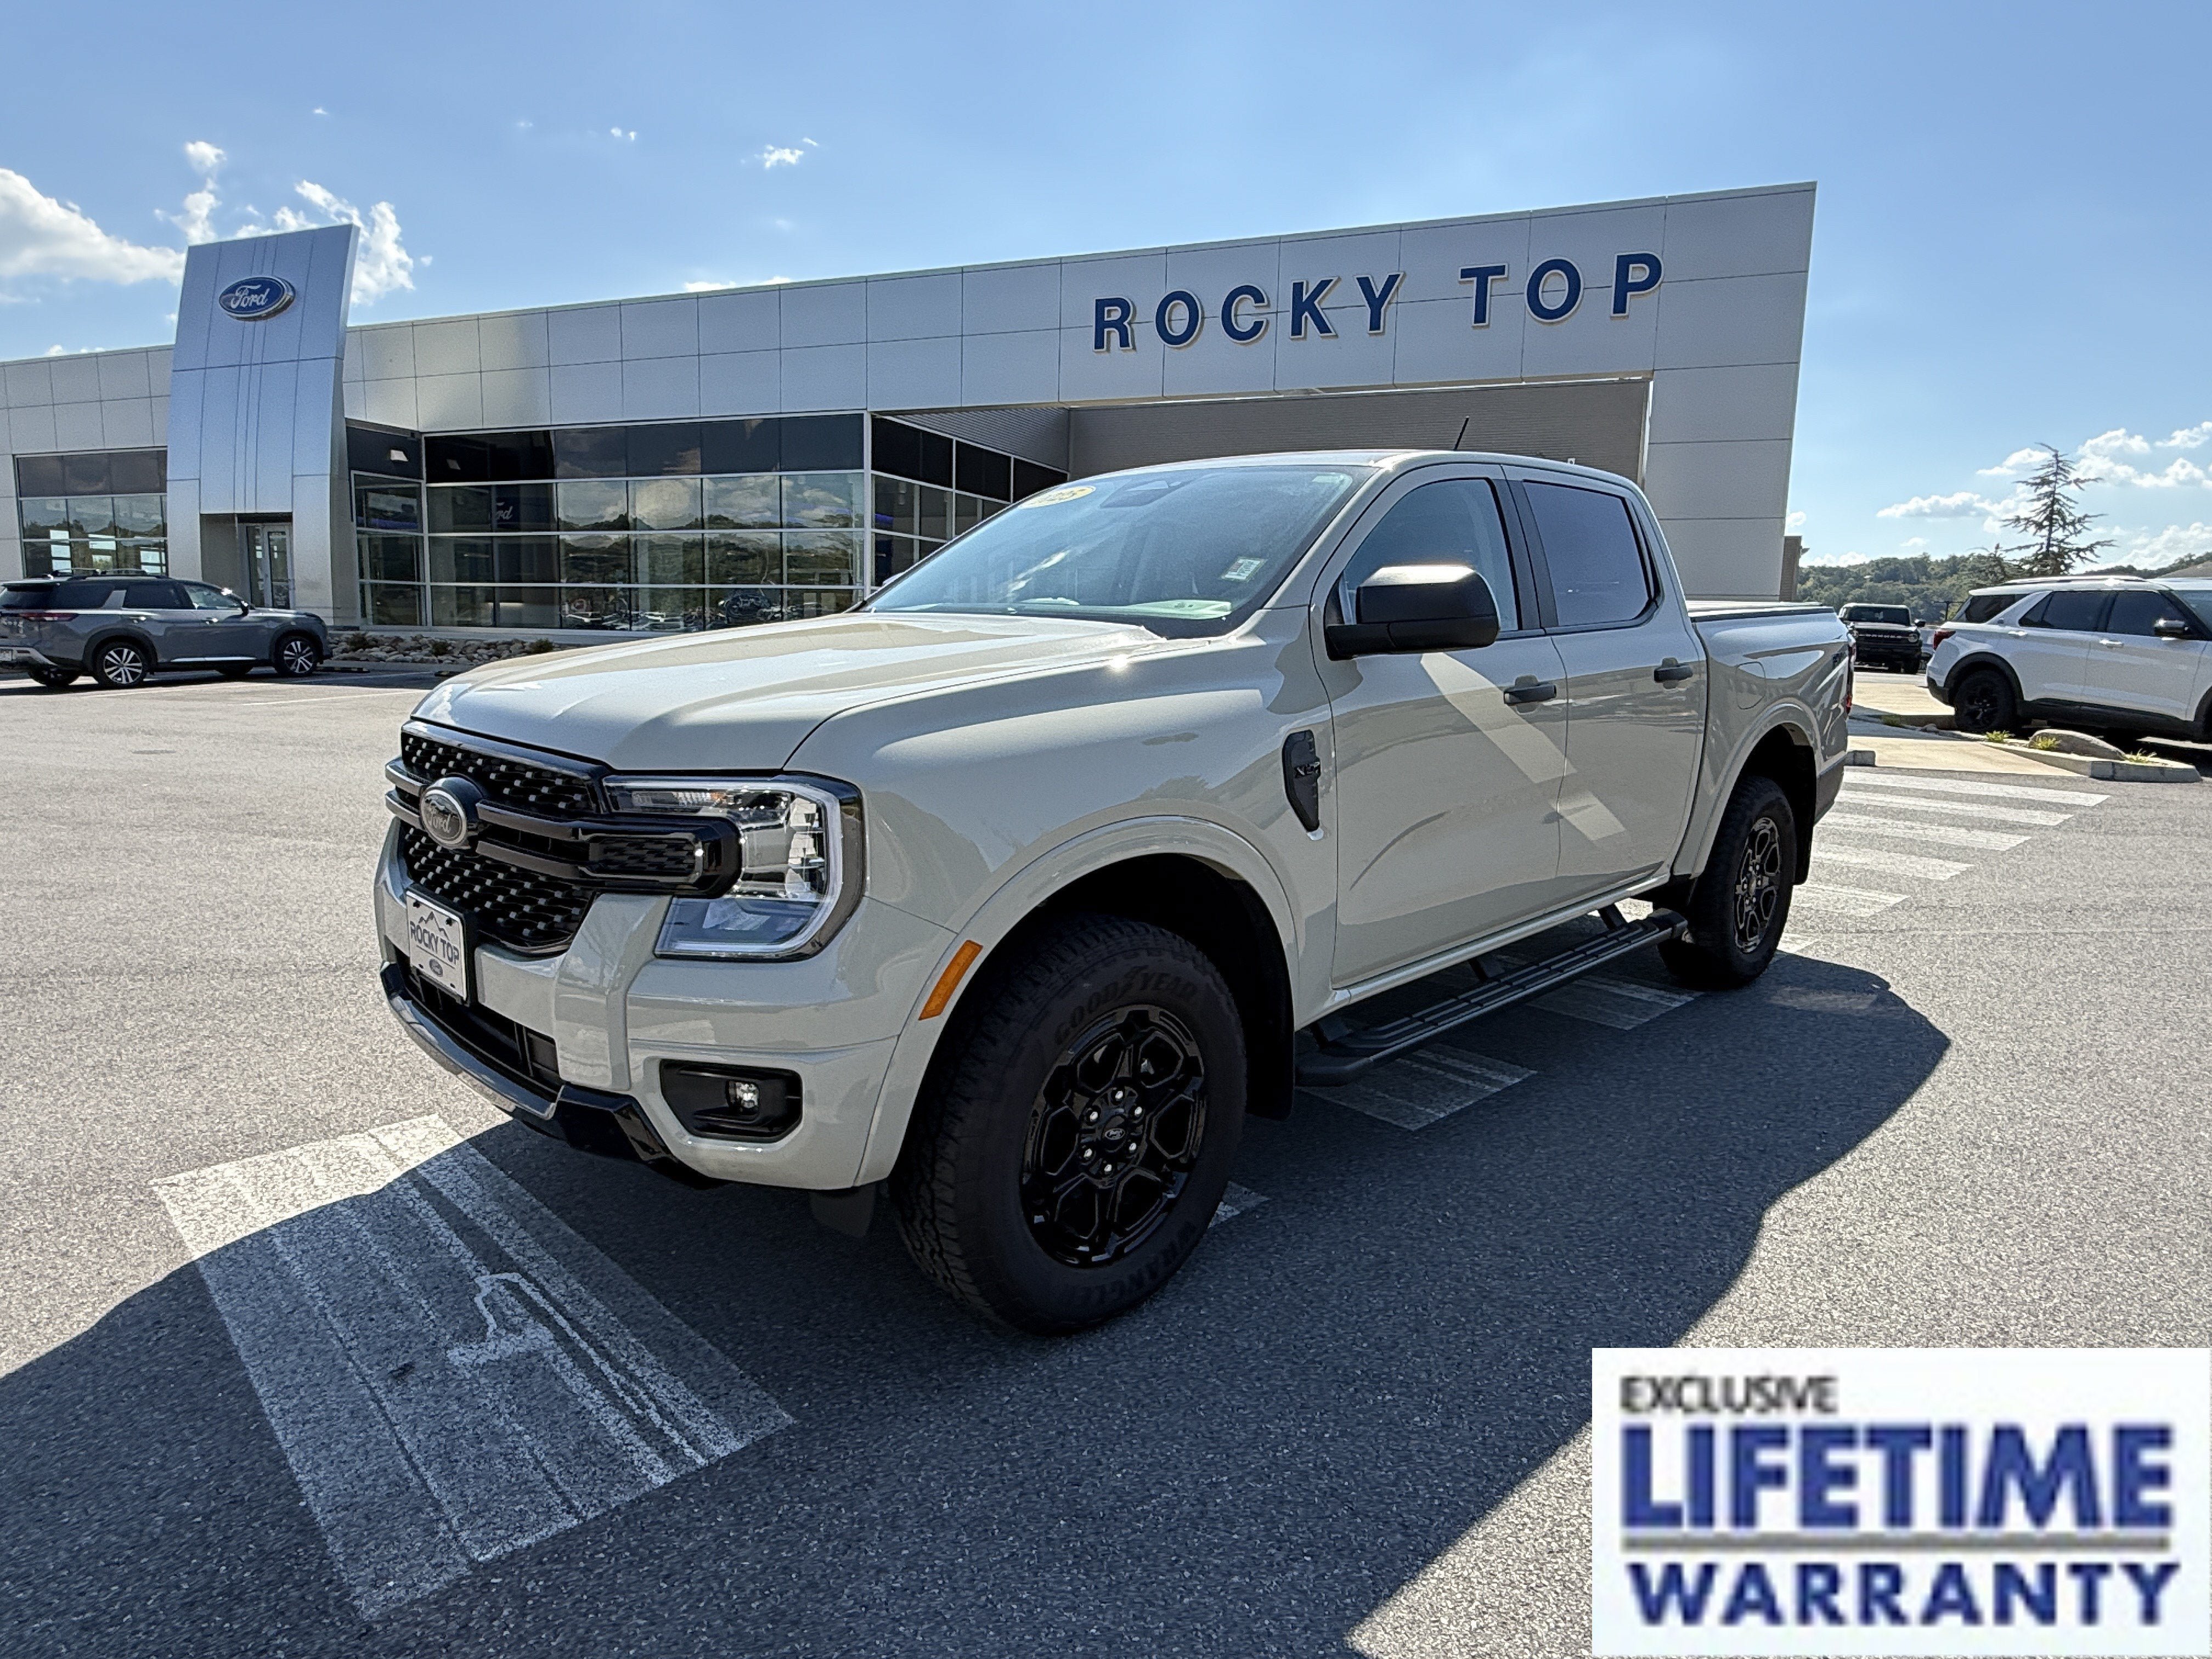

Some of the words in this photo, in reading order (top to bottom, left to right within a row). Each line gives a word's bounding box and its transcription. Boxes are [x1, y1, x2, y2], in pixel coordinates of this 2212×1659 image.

[230, 284, 270, 309] Ford
[1093, 271, 1406, 352] ROCKY
[1459, 251, 1664, 327] TOP
[409, 921, 438, 954] ROCKY
[440, 937, 460, 966] TOP
